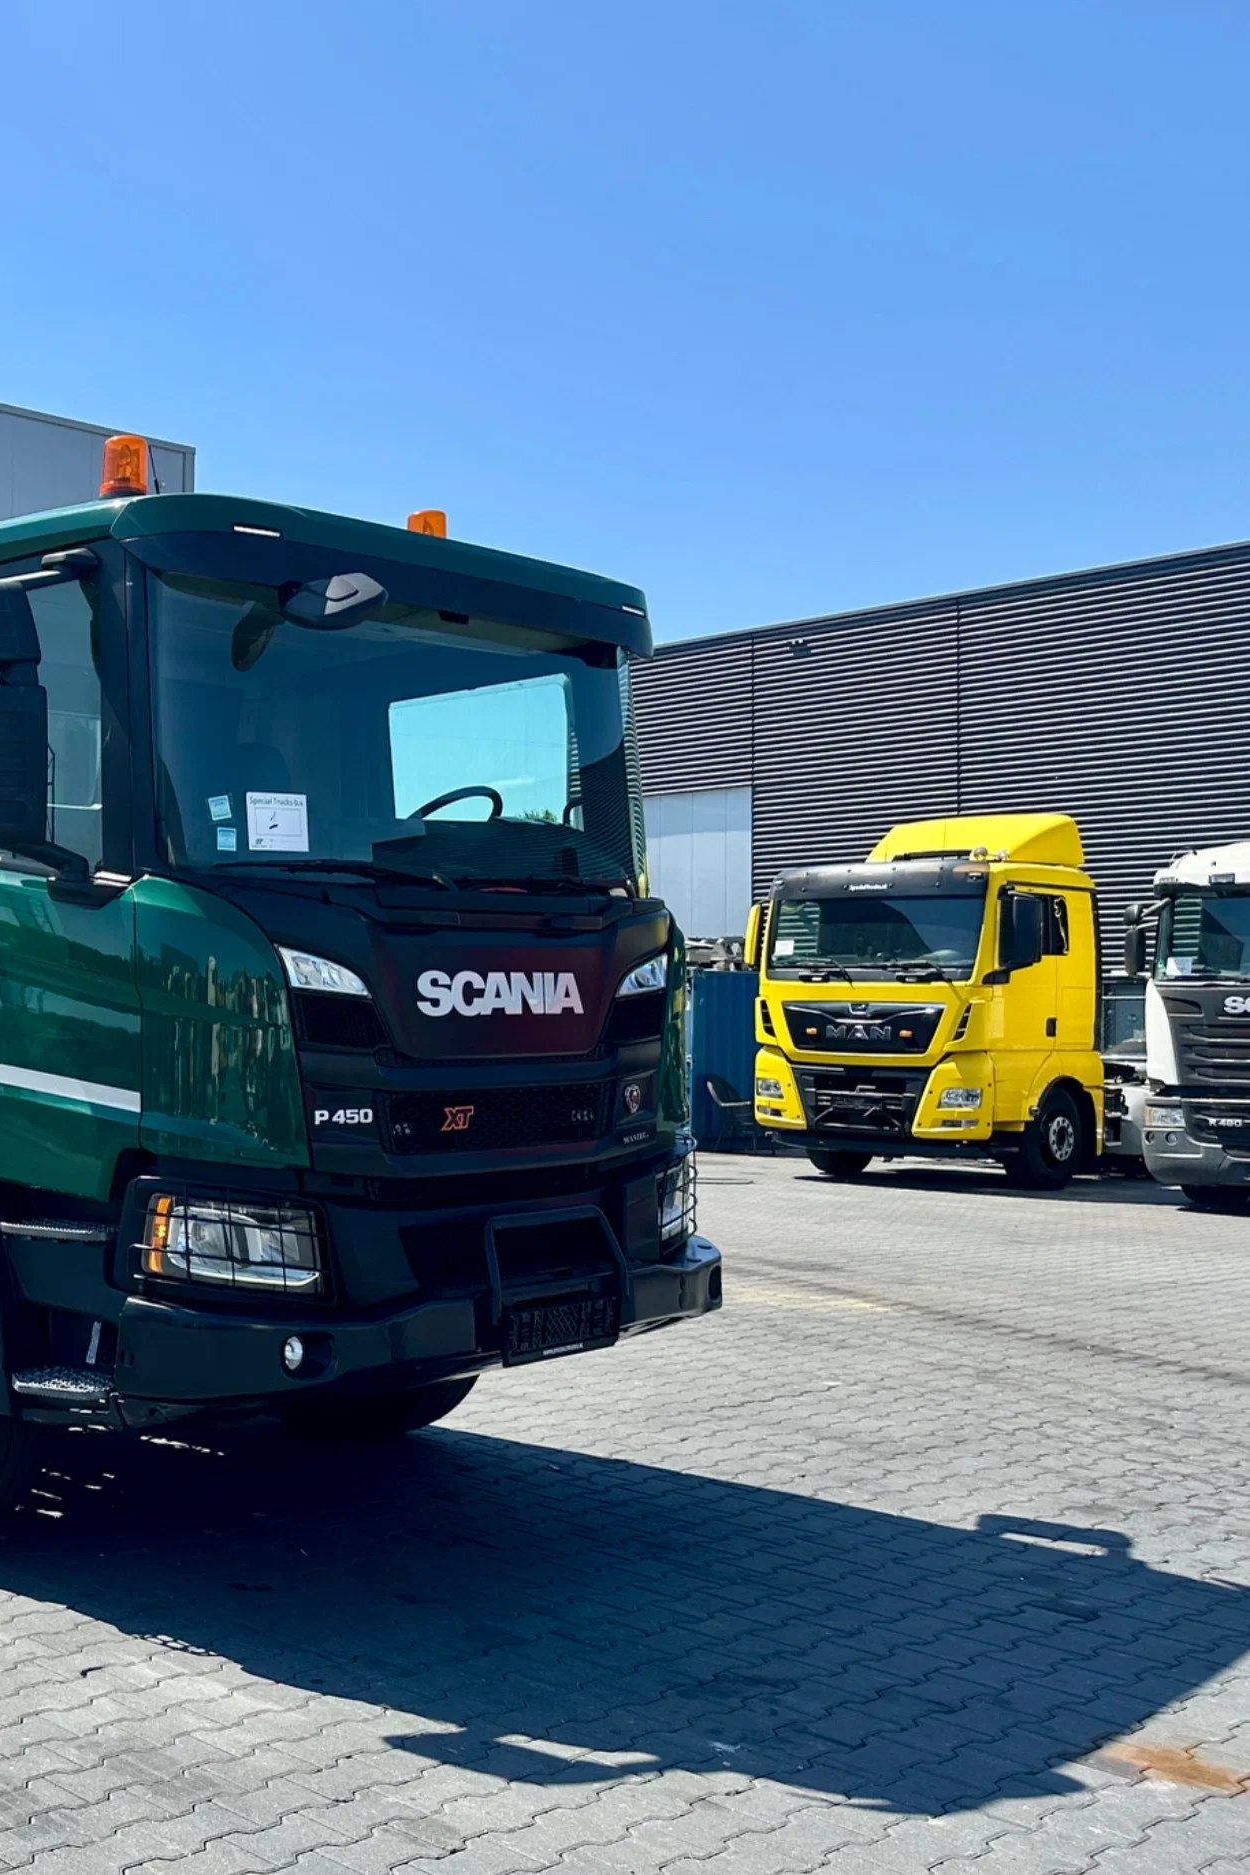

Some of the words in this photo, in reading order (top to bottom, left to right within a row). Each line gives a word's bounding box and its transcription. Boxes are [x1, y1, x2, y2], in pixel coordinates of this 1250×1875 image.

[416, 969, 585, 1017] SCANIA
[1223, 996, 1250, 1014] S
[825, 1024, 892, 1040] MAN
[314, 1109, 329, 1125] P
[332, 1108, 373, 1124] 450
[440, 1104, 474, 1131] XT
